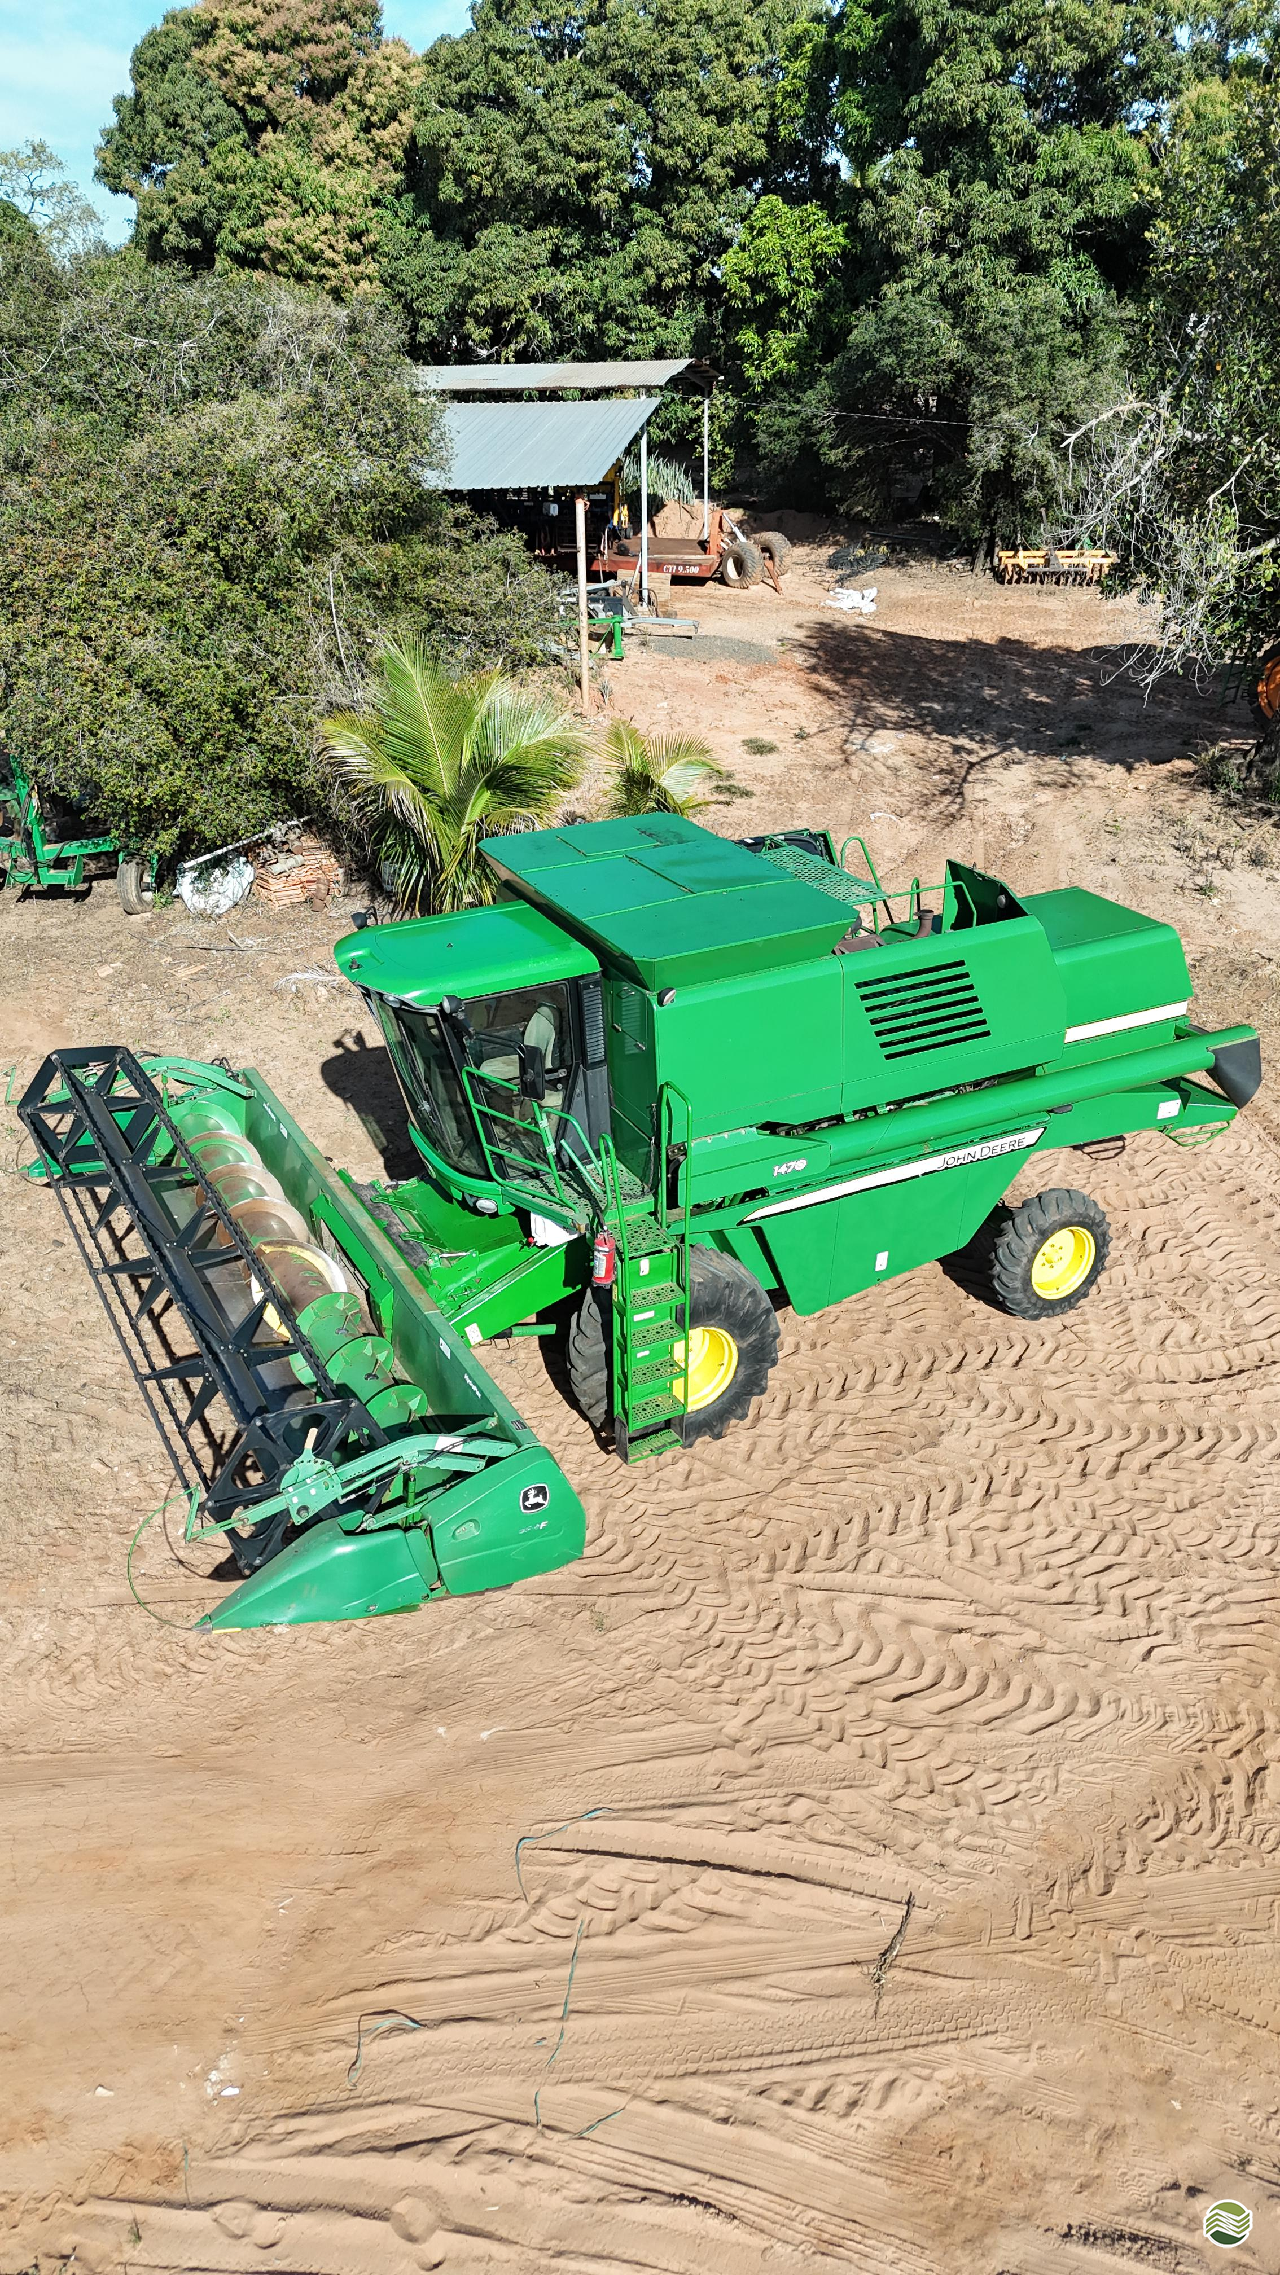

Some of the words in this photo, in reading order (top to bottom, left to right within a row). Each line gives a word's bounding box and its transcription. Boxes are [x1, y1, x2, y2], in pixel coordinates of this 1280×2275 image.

[937, 1151, 977, 1169] JOHN
[980, 1137, 1026, 1158] DEERE
[773, 1158, 807, 1177] 1470
